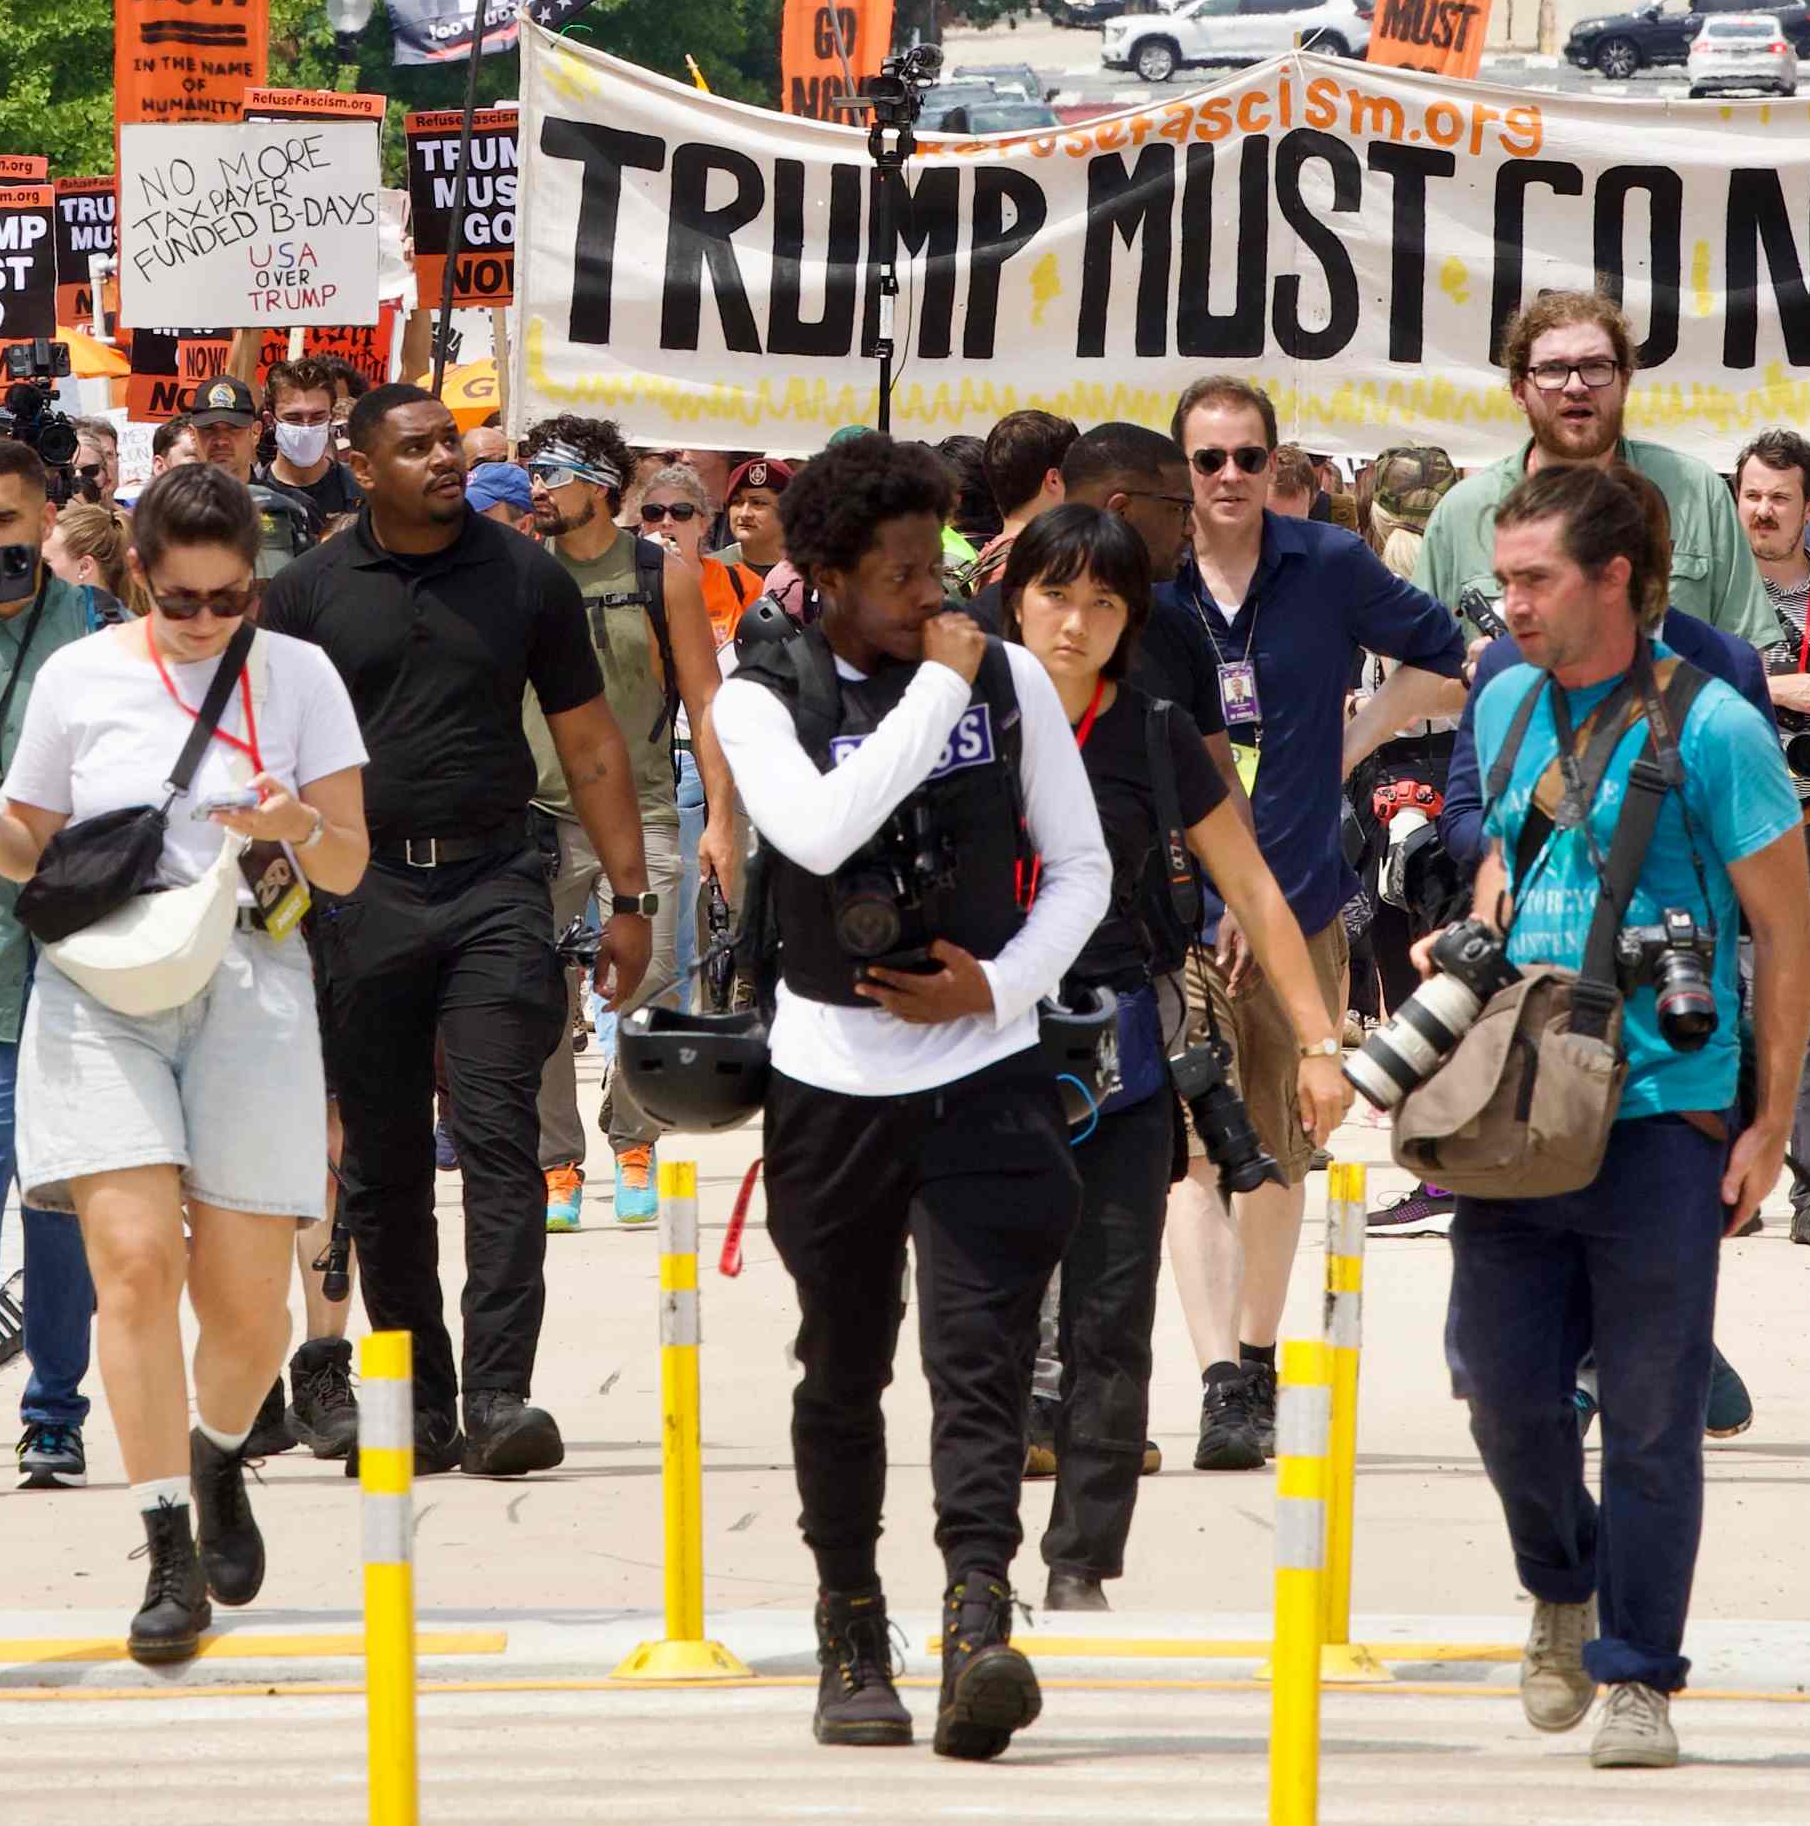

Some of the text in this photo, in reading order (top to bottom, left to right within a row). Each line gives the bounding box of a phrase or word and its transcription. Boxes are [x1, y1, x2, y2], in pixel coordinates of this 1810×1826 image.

[814, 6, 858, 60] GO
[133, 56, 254, 78] IN THE NAME
[182, 78, 206, 92] OF
[141, 97, 243, 116] HUMANITY
[251, 92, 373, 113] RefuseFascism.org
[138, 134, 331, 207] NO MORE
[133, 192, 376, 283] FUNDED B-DAYS
[463, 212, 518, 246] GO
[541, 117, 1048, 359] TRUMP
[1077, 127, 1456, 364] MUST
[249, 241, 318, 270] USA
[255, 270, 311, 288] OVER
[247, 284, 337, 313] TRUMP
[185, 346, 228, 378] NOW!
